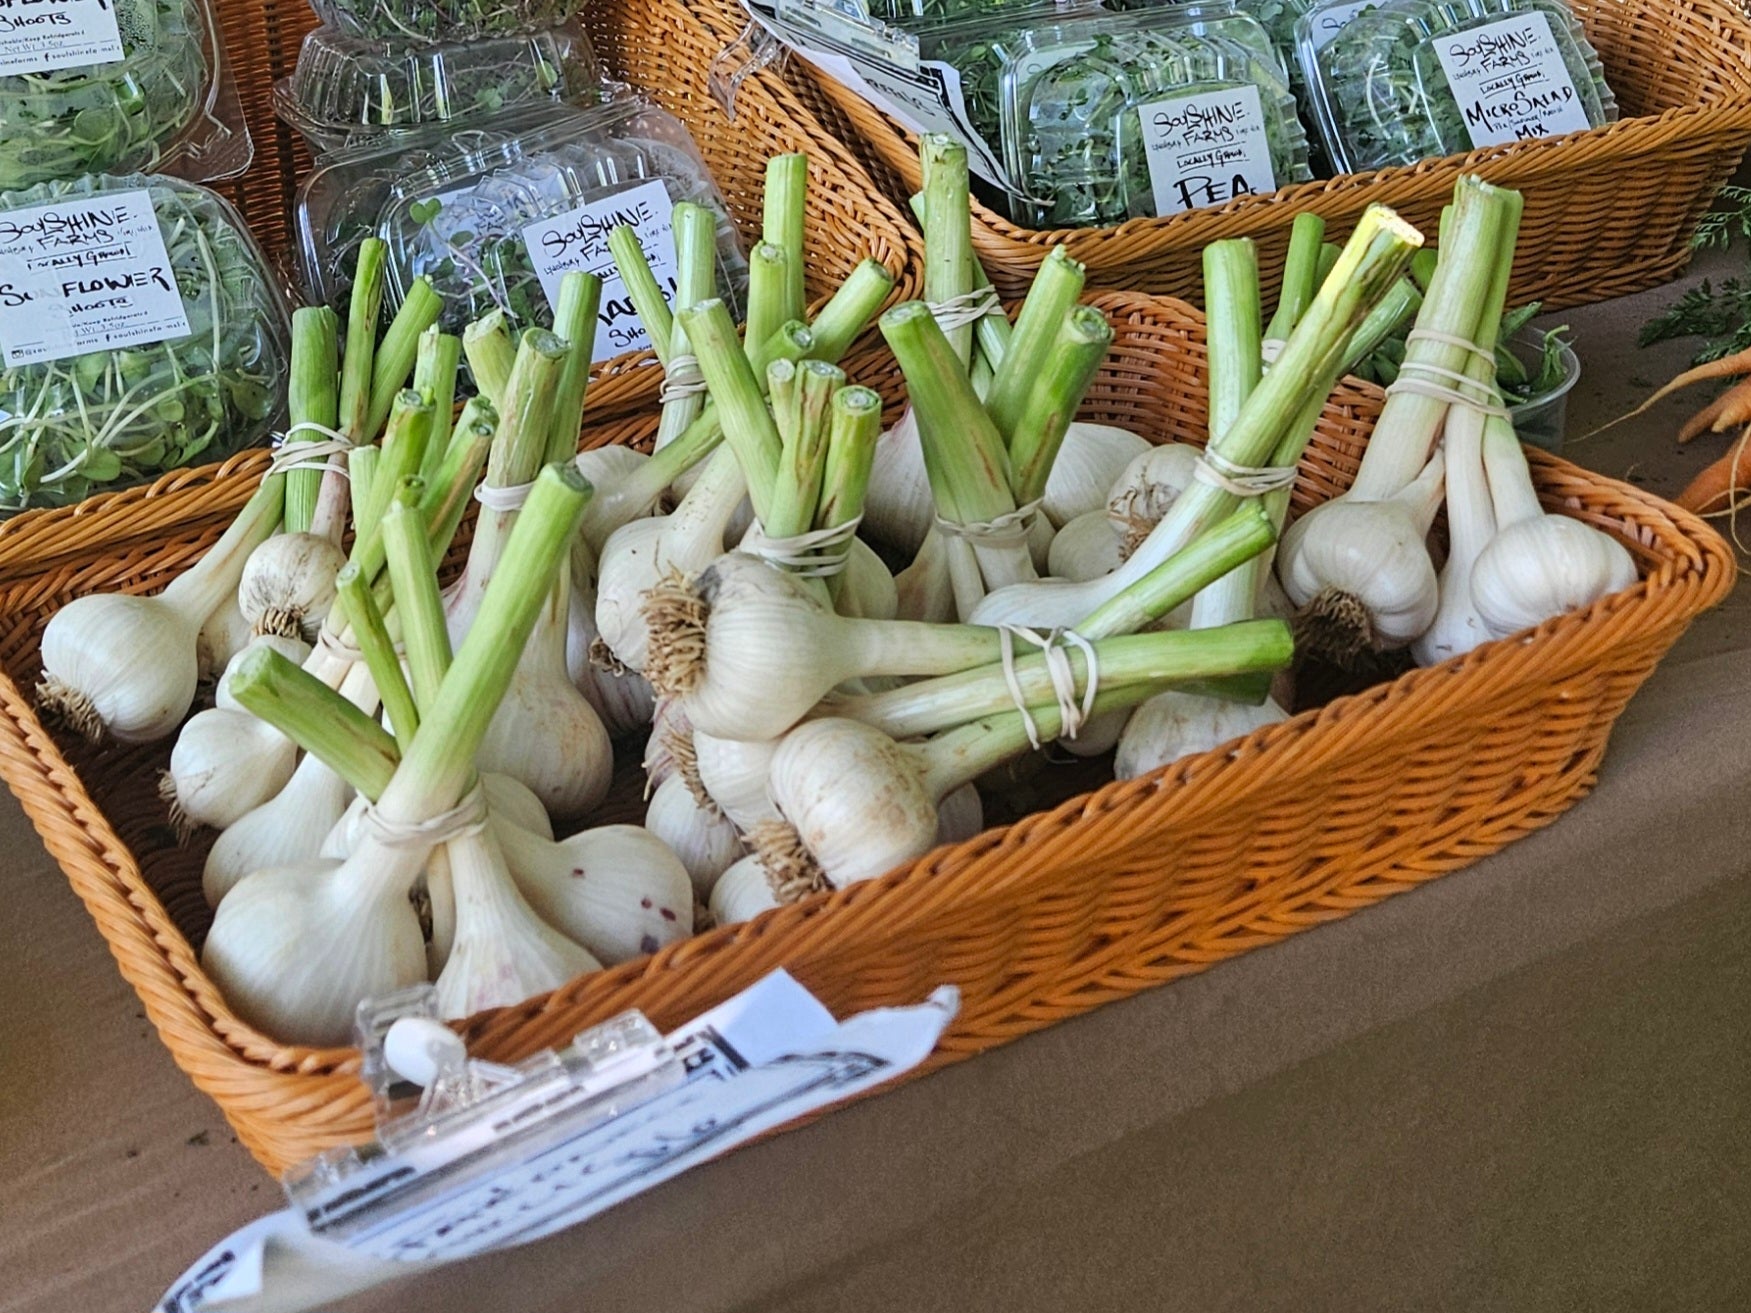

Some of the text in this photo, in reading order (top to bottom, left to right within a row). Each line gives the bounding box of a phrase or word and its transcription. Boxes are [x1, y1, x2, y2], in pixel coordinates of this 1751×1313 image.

[1480, 51, 1531, 74] FARMS
[1182, 126, 1234, 147] FARMS
[1515, 123, 1549, 140] MIX
[1173, 174, 1249, 209] PEA
[36, 229, 114, 250] FARMS
